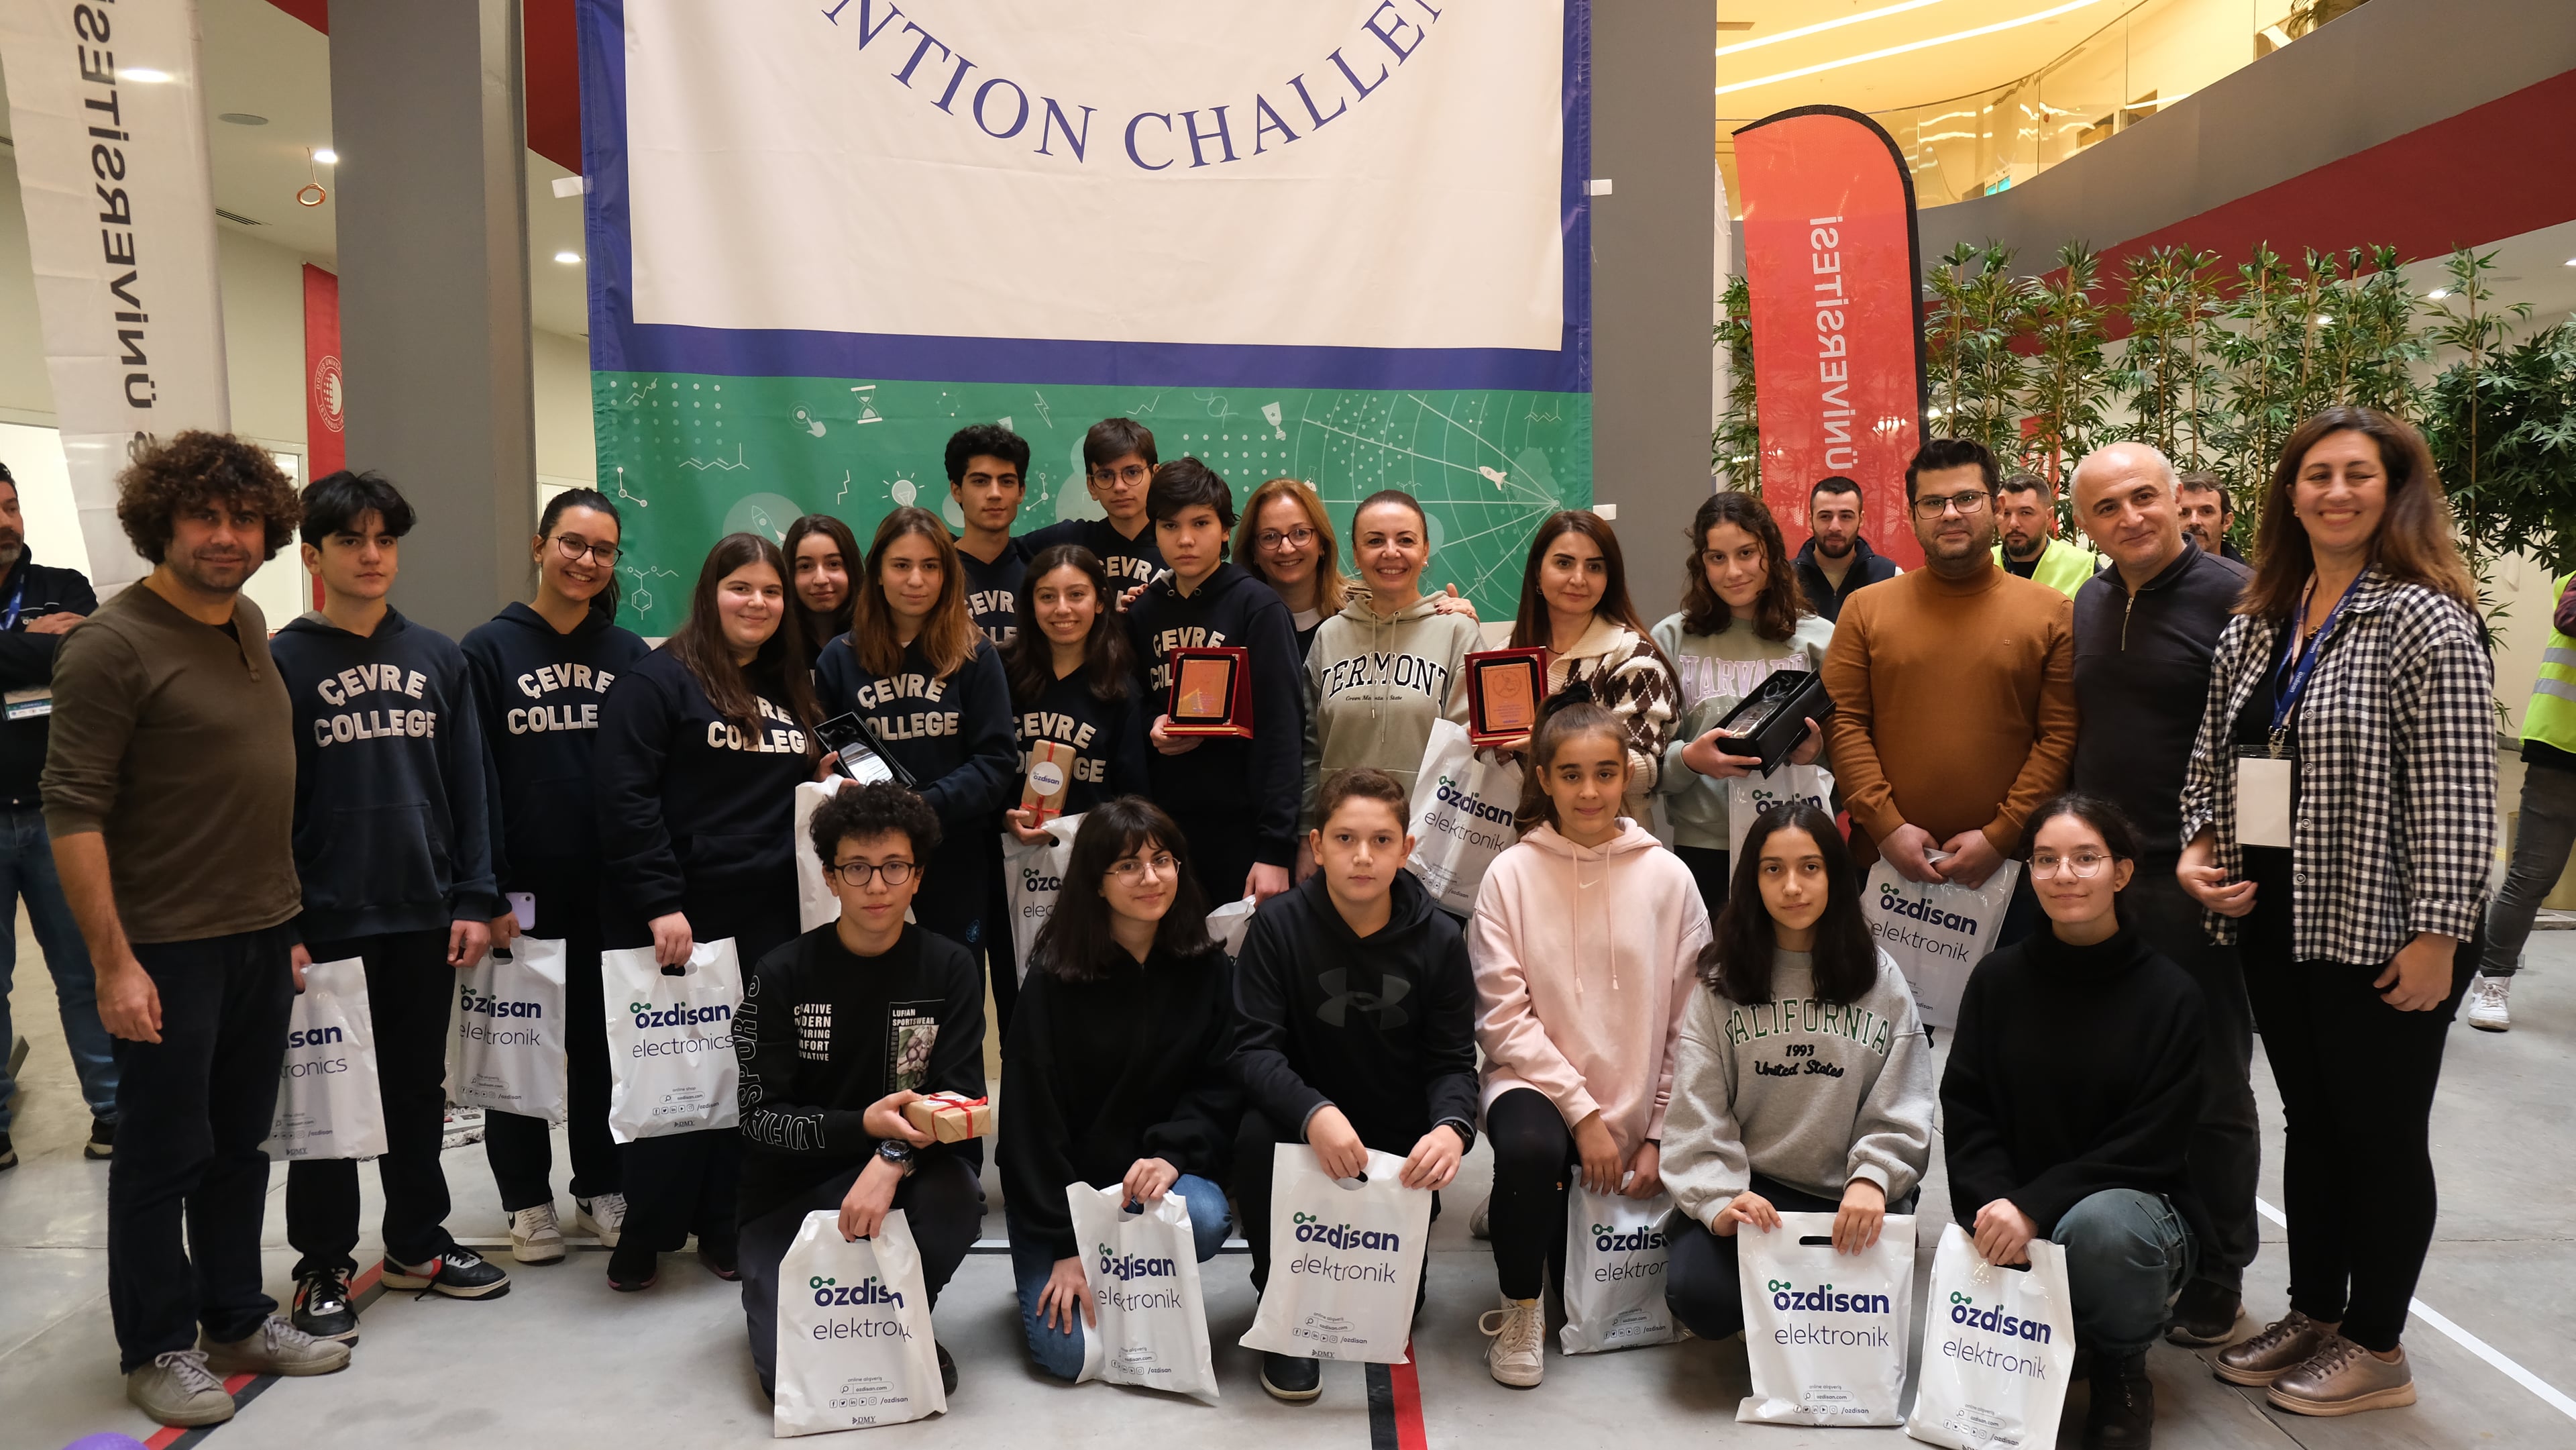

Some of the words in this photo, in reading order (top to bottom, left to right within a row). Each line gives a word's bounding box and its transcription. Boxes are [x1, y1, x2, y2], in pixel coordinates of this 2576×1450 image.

[1124, 0, 1442, 170] CHALLE
[1097, 556, 1166, 585] EVR
[964, 589, 1015, 619] EVR
[317, 663, 427, 707] ÇEVRE
[517, 662, 615, 699] ÇEVRE
[857, 674, 947, 710] ÇEVRE
[315, 708, 437, 748] COLLEGE
[869, 712, 959, 741] OLLEGE
[1424, 811, 1505, 853] elektronik
[1880, 882, 1978, 936] özdisan
[1871, 921, 1970, 963] elektronik
[630, 1001, 731, 1029] özdisan
[892, 1008, 916, 1017] LUFIAN
[892, 1017, 934, 1026] SPORTSWEAR
[632, 1033, 735, 1058] electronics
[1785, 1044, 1815, 1057] 1993
[1754, 1060, 1801, 1077] United
[1803, 1059, 1845, 1078] States
[1293, 1211, 1400, 1252] özdisan
[1592, 1223, 1669, 1251] özdis
[1291, 1253, 1396, 1283] elektronik
[809, 1276, 905, 1312] özdisn
[1768, 1278, 1890, 1314] özdisan
[1950, 1291, 2051, 1345] özdisan
[1340, 1336, 1368, 1344] /ozdisan
[1774, 1323, 1890, 1347] elektronik
[1943, 1337, 2046, 1380] elektronik
[880, 1396, 908, 1405] /ozdisan
[1841, 1406, 1870, 1414] /ozdisan
[858, 1415, 876, 1423] DMY
